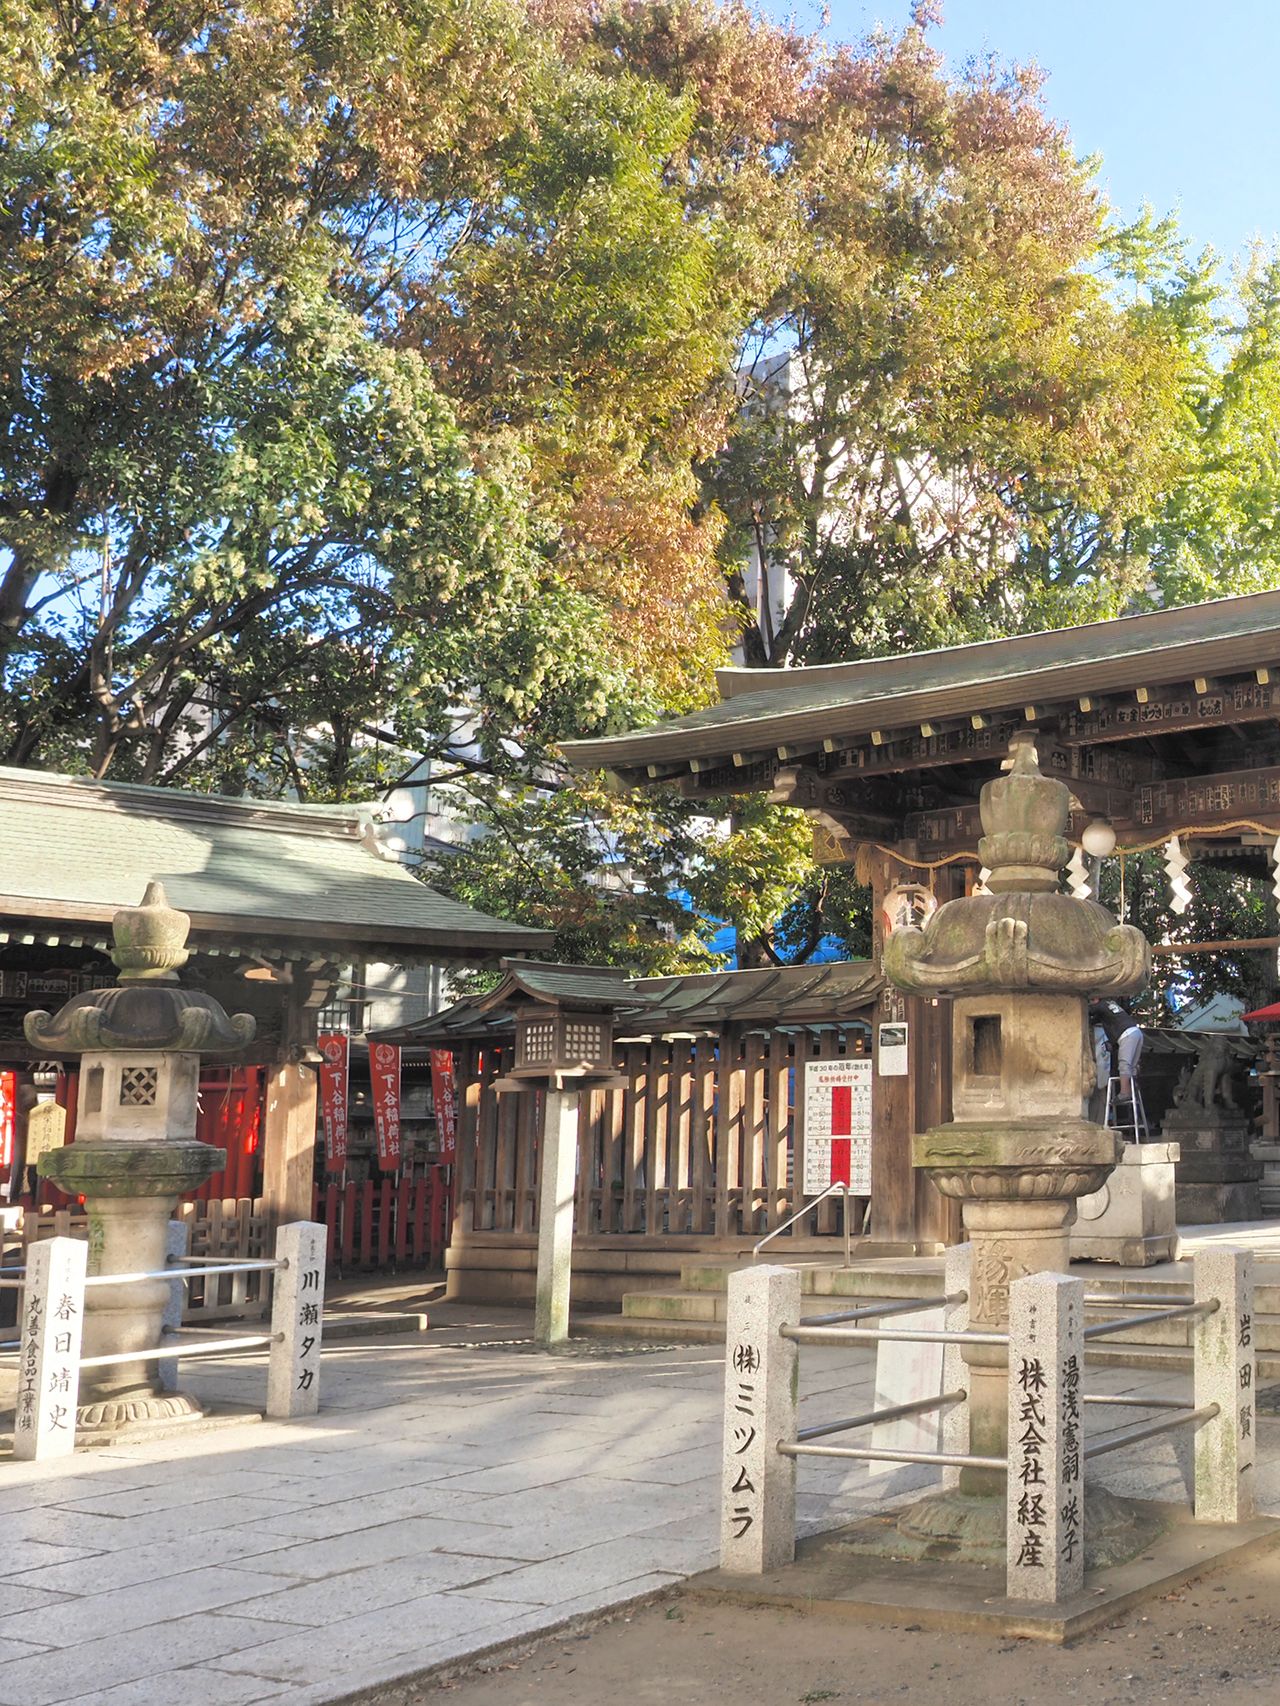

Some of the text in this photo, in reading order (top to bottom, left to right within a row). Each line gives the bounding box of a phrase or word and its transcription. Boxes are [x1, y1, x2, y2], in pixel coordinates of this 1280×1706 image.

[330, 1072, 346, 1157] 下谷稲荷社
[381, 1073, 400, 1157] 下谷稲荷社
[440, 1071, 455, 1152] 下谷稲荷社
[48, 1293, 78, 1432] 春日靖史
[296, 1270, 320, 1391] 川瀬タカ
[1237, 1313, 1253, 1474] 岩田賢一
[731, 1344, 761, 1539] (株)ミツムラ
[1015, 1357, 1048, 1569] 株式会社経産
